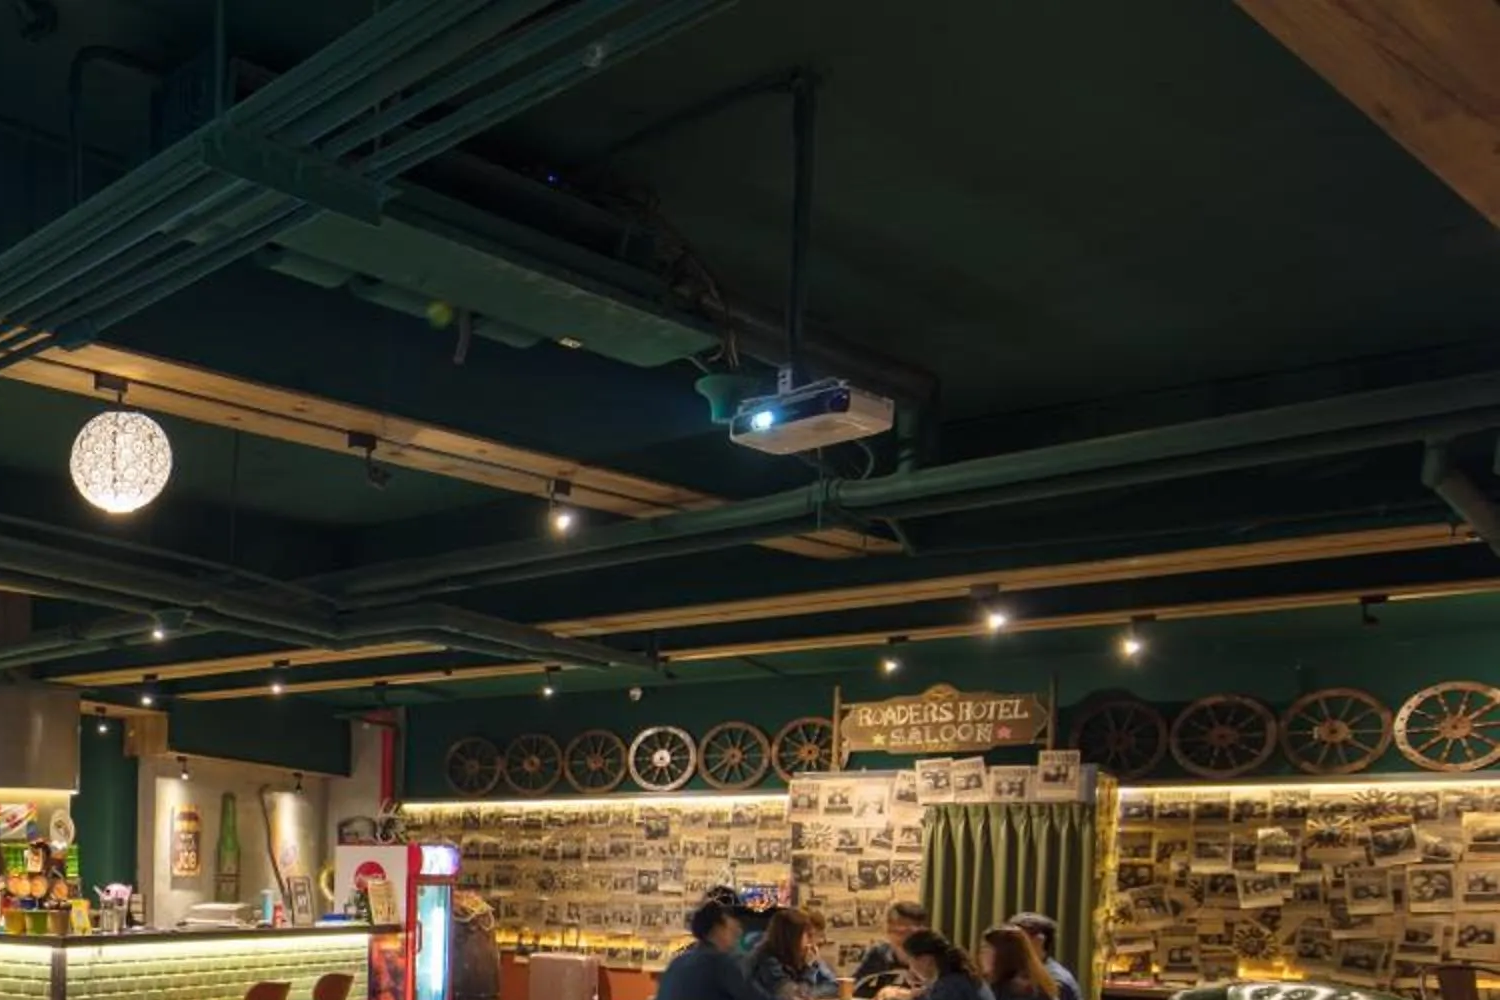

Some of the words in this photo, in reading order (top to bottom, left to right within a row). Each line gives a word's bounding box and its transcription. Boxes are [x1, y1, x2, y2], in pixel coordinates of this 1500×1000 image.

[858, 702, 955, 726] ROADERS
[958, 699, 1029, 722] HOTEL
[890, 723, 994, 746] SALOON
